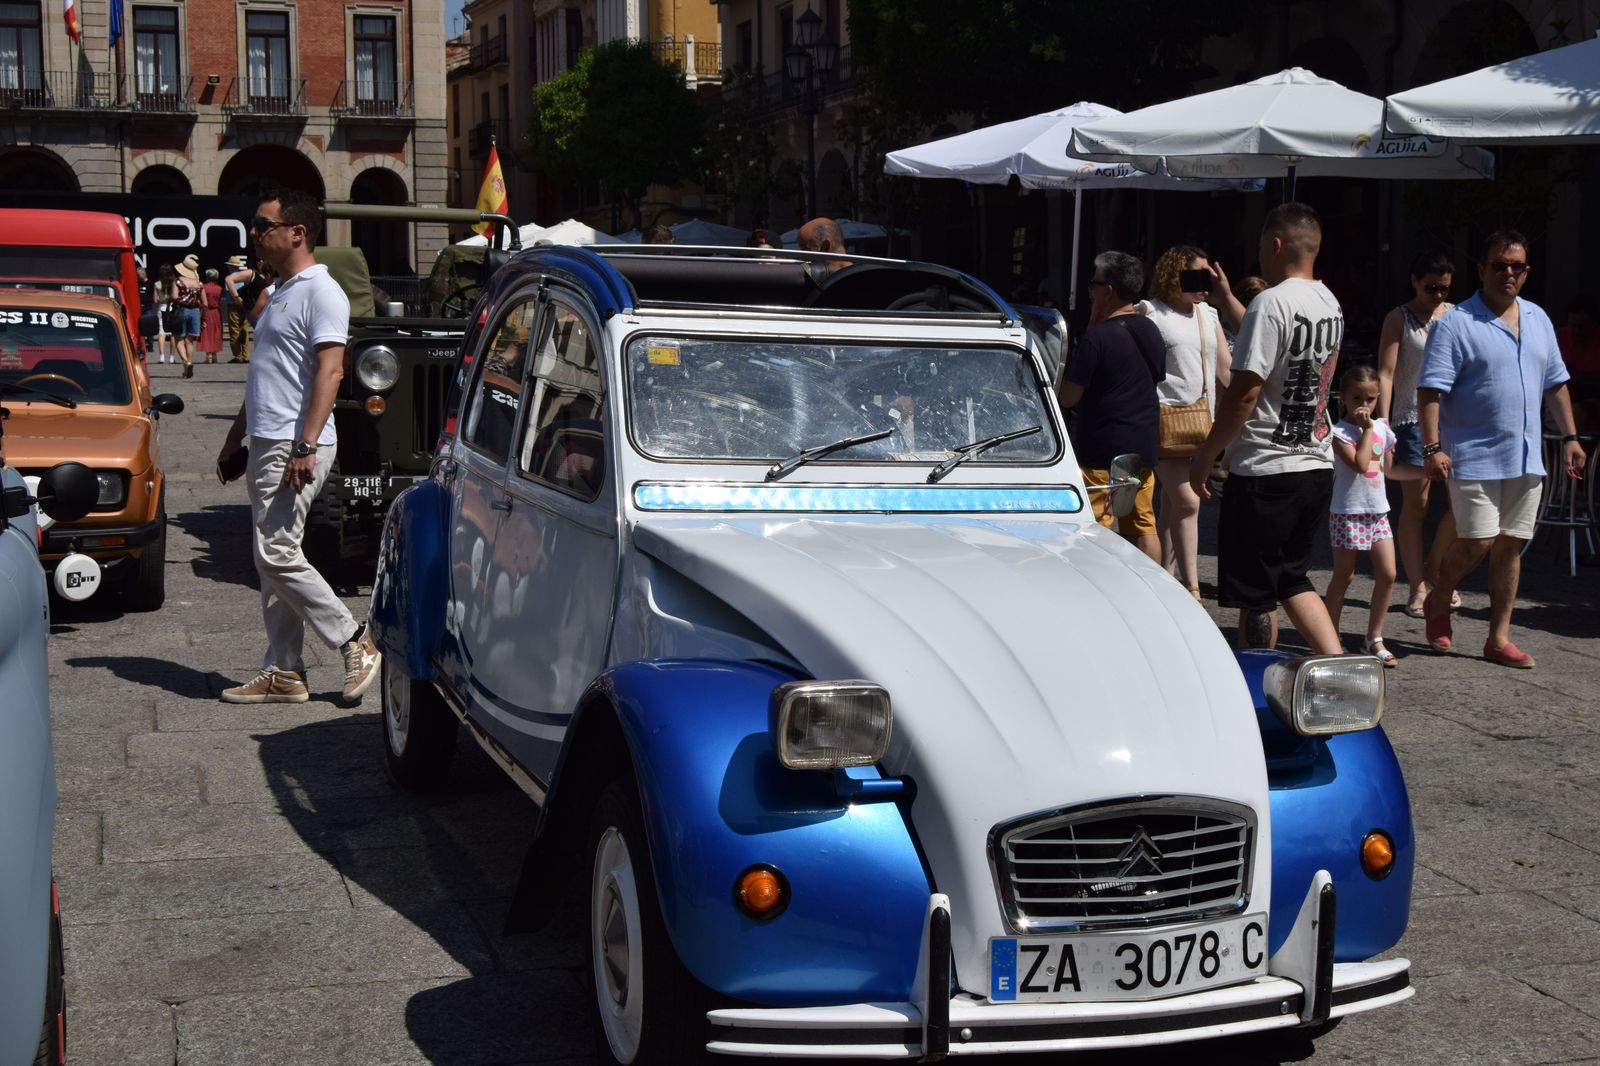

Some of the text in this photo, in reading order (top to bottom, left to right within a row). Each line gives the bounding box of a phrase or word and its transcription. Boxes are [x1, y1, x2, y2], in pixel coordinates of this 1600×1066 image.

[432, 349, 456, 358] Jeep
[999, 922, 1264, 993] E ZA 3078 C
